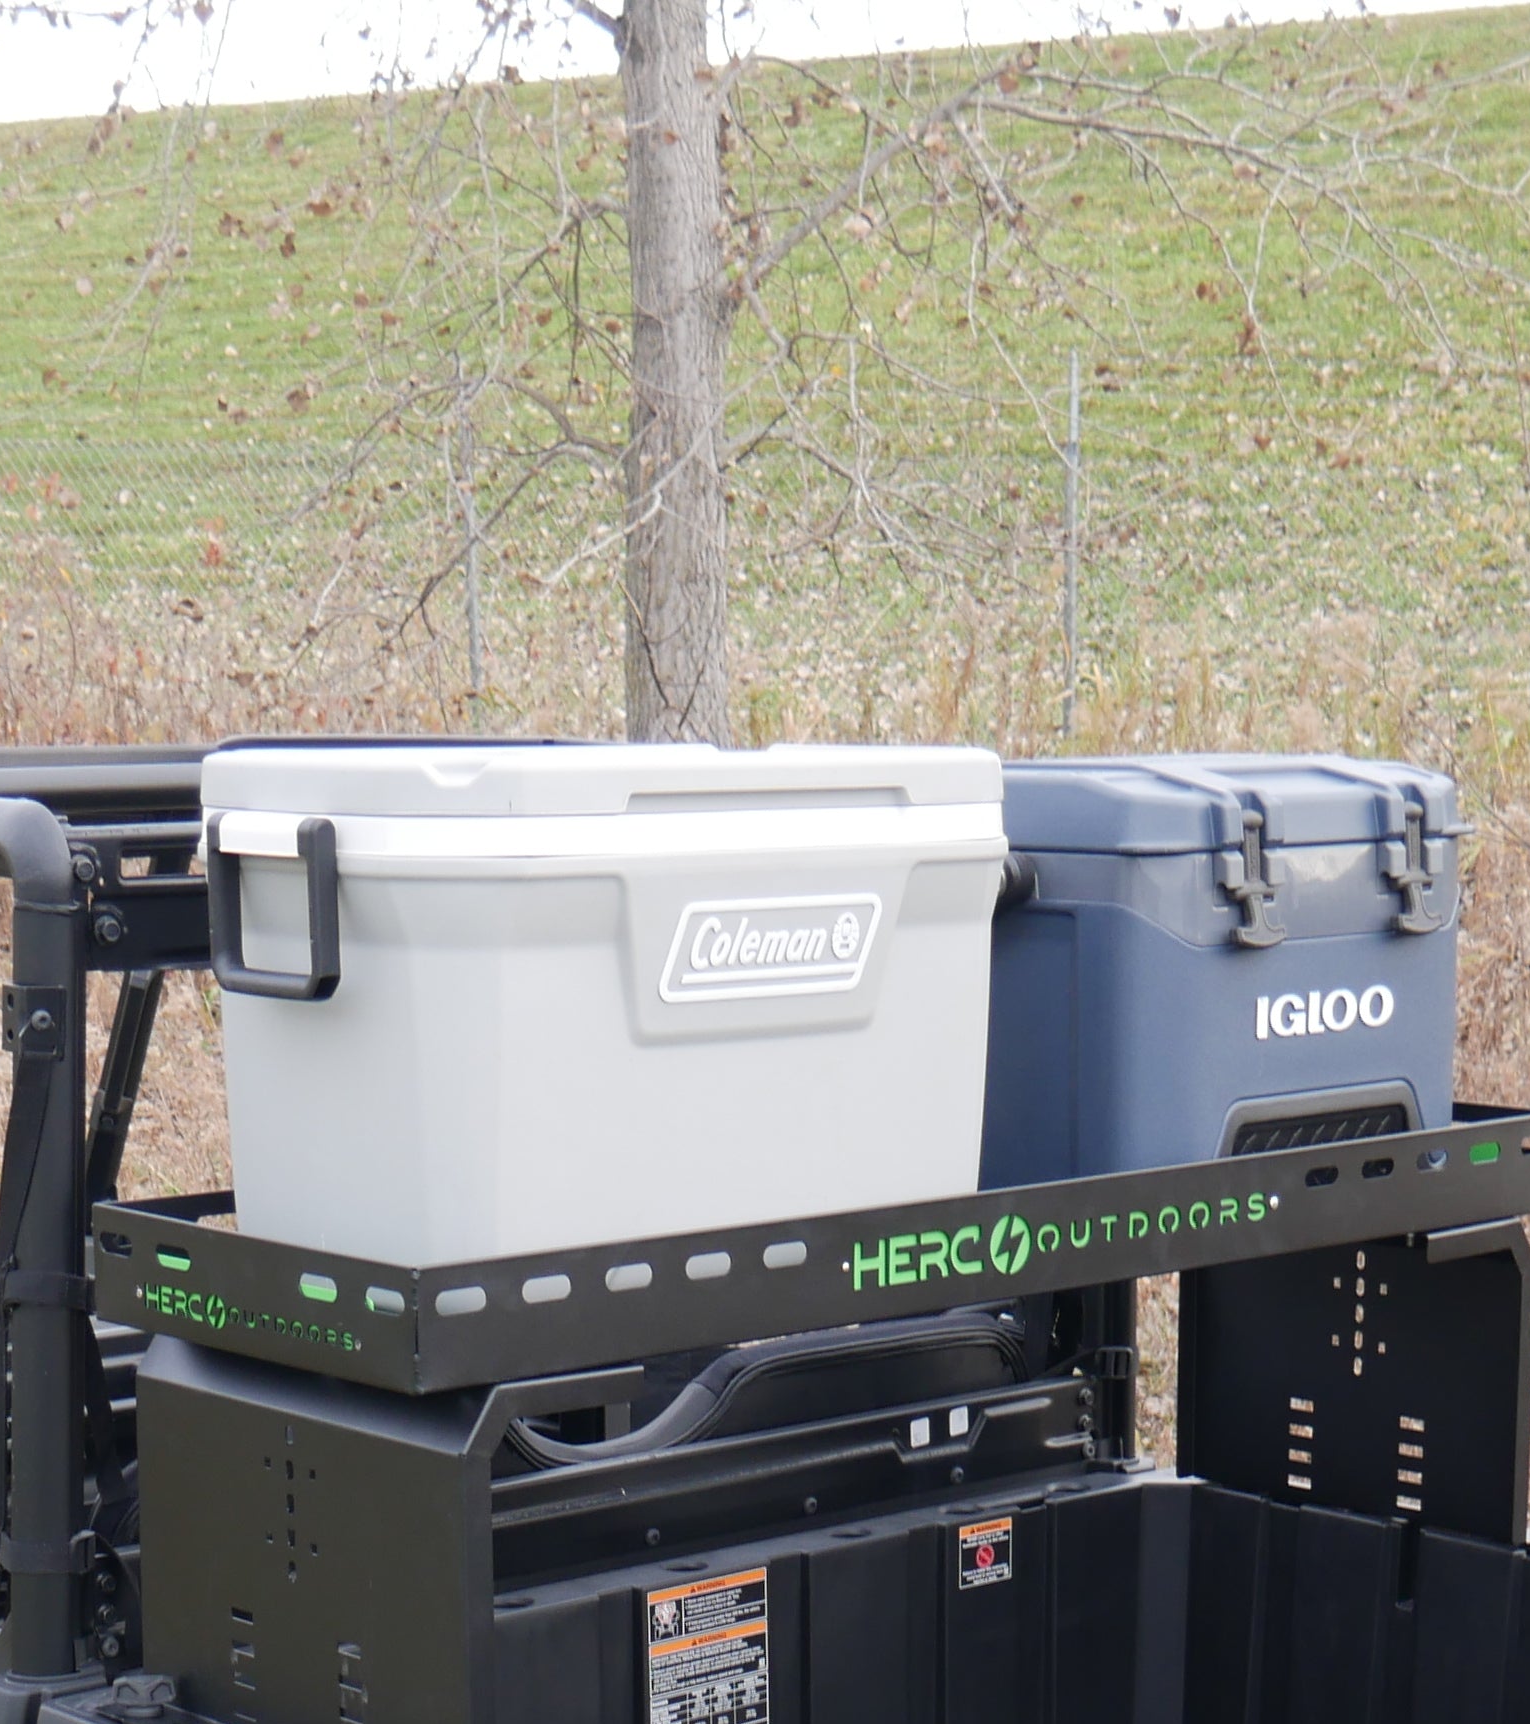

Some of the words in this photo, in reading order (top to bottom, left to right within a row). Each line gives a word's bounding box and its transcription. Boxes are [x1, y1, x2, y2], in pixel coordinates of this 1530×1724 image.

[690, 916, 827, 970] Coleman
[1256, 984, 1395, 1040] IGLOO
[1036, 1192, 1267, 1253] OUTDOORS
[226, 1306, 355, 1351] OUTDOORS
